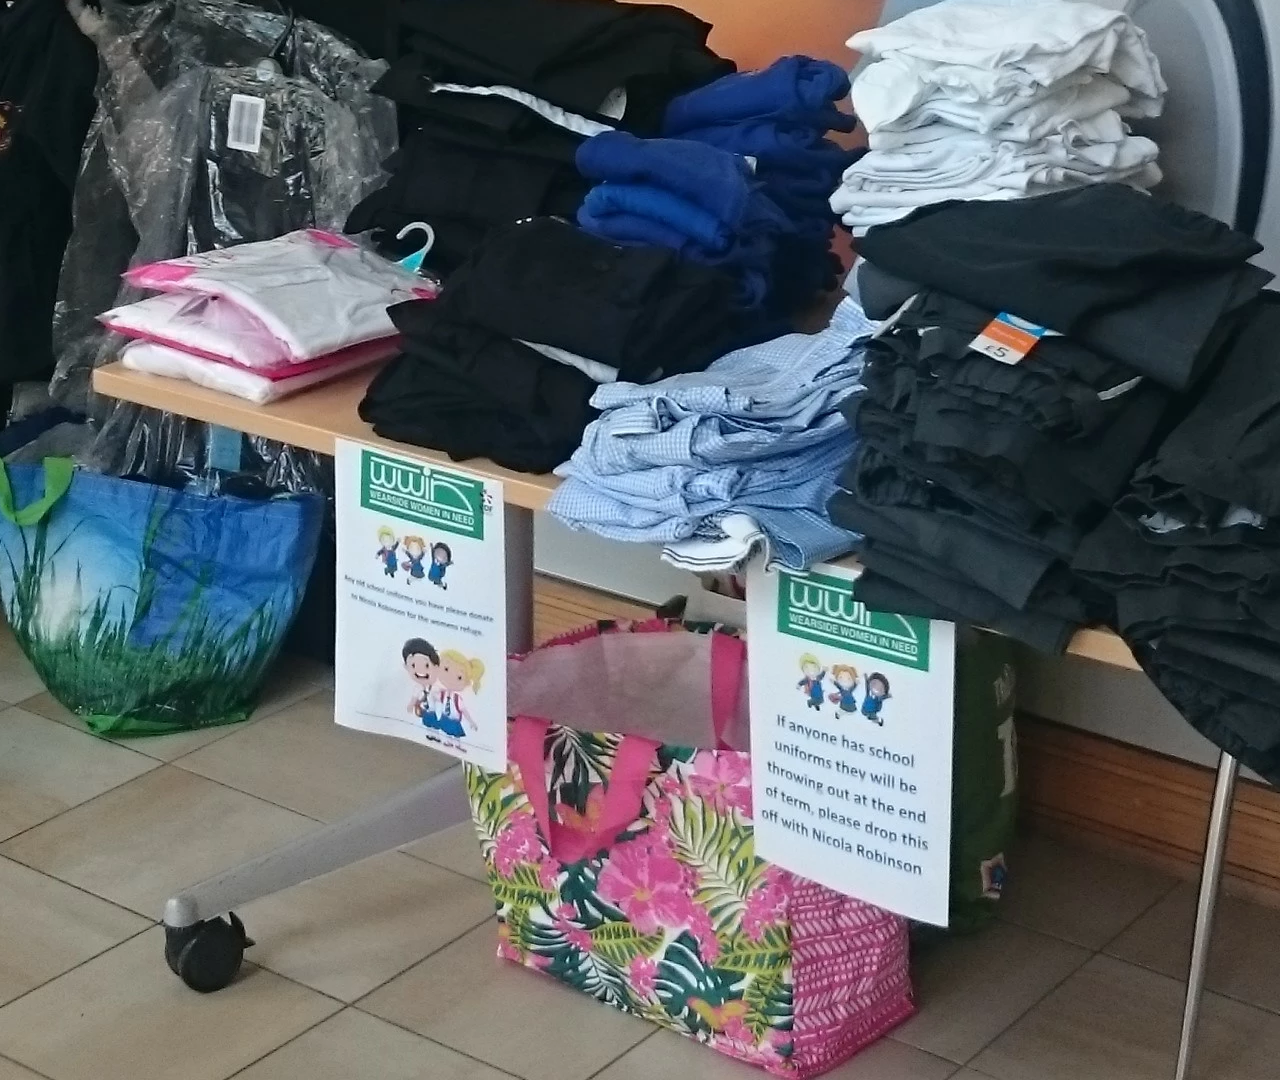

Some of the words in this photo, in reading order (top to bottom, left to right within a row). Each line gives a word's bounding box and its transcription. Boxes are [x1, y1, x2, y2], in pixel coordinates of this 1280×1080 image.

[983, 344, 1010, 359] £5
[369, 490, 408, 508] WEARSIDE
[410, 501, 441, 517] WOMEN
[442, 510, 450, 520] IN
[452, 513, 474, 526] NEED
[789, 613, 838, 634] WEARSIDE
[840, 626, 877, 645] WOMEN
[879, 635, 889, 647] IN
[891, 639, 918, 655] NEED
[775, 741, 832, 769] uniforms
[836, 761, 866, 780] they
[870, 773, 894, 789] will
[900, 779, 917, 794] be
[777, 714, 785, 727] If
[789, 720, 837, 744] anyone
[842, 734, 865, 753] has
[869, 746, 914, 768] school
[765, 786, 778, 799] of
[781, 792, 814, 815] term,
[819, 807, 861, 830] please
[865, 823, 897, 843] drop
[902, 833, 928, 851] this
[767, 761, 823, 794] throwing
[827, 785, 849, 801] out
[854, 794, 867, 807] at
[872, 798, 894, 814] the
[899, 808, 926, 823] end
[762, 809, 778, 823] off
[781, 816, 809, 838] with
[813, 828, 852, 852] Nicola
[857, 844, 922, 875] Robinson
